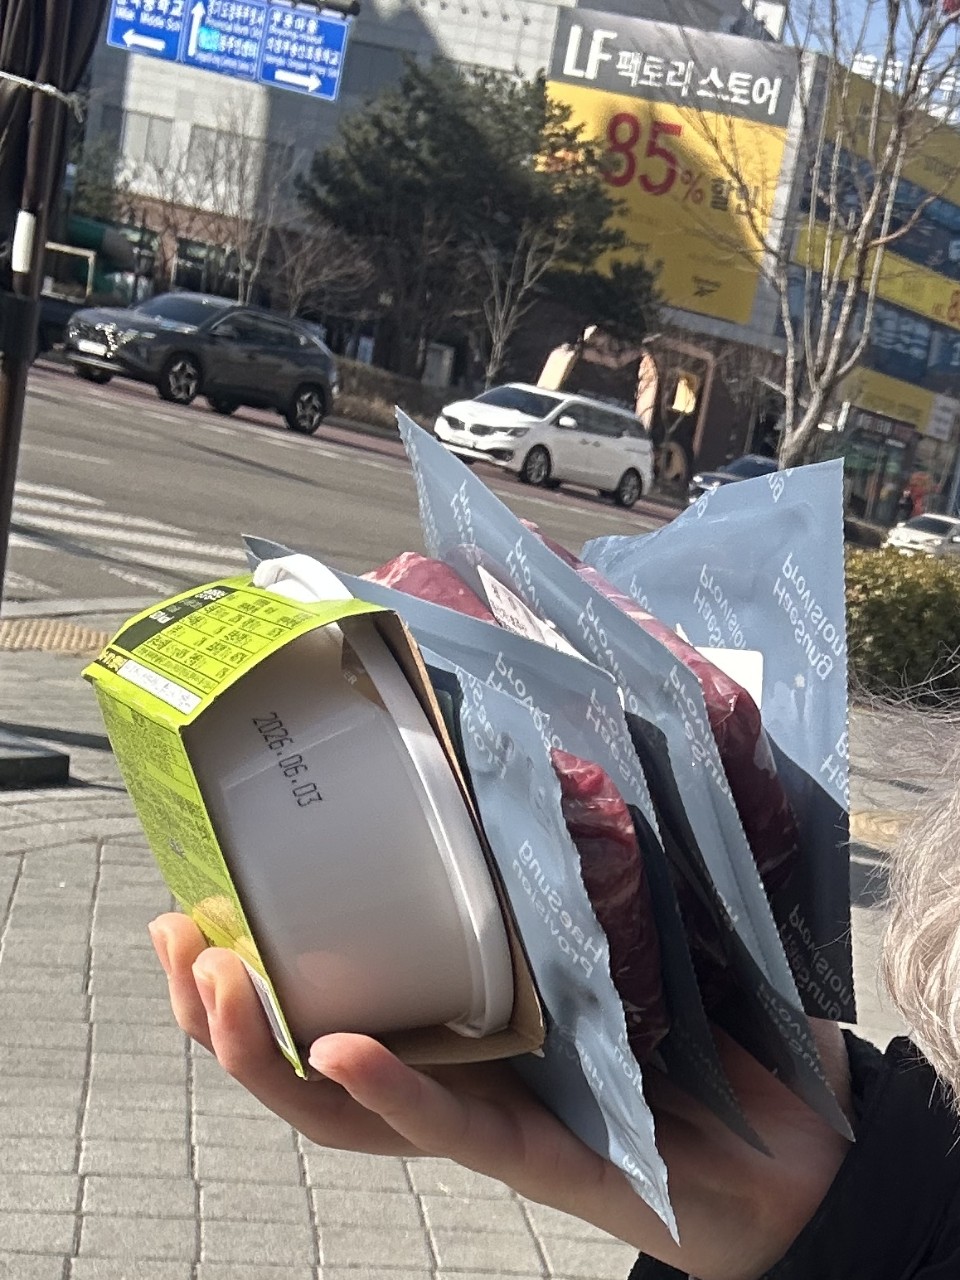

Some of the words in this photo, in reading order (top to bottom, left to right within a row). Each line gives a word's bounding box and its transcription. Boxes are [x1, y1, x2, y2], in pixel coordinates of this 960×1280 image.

[563, 24, 618, 79] LF
[616, 51, 695, 97] 팩토리
[696, 67, 782, 115] 스토어
[251, 712, 324, 809] 2026.06.03
